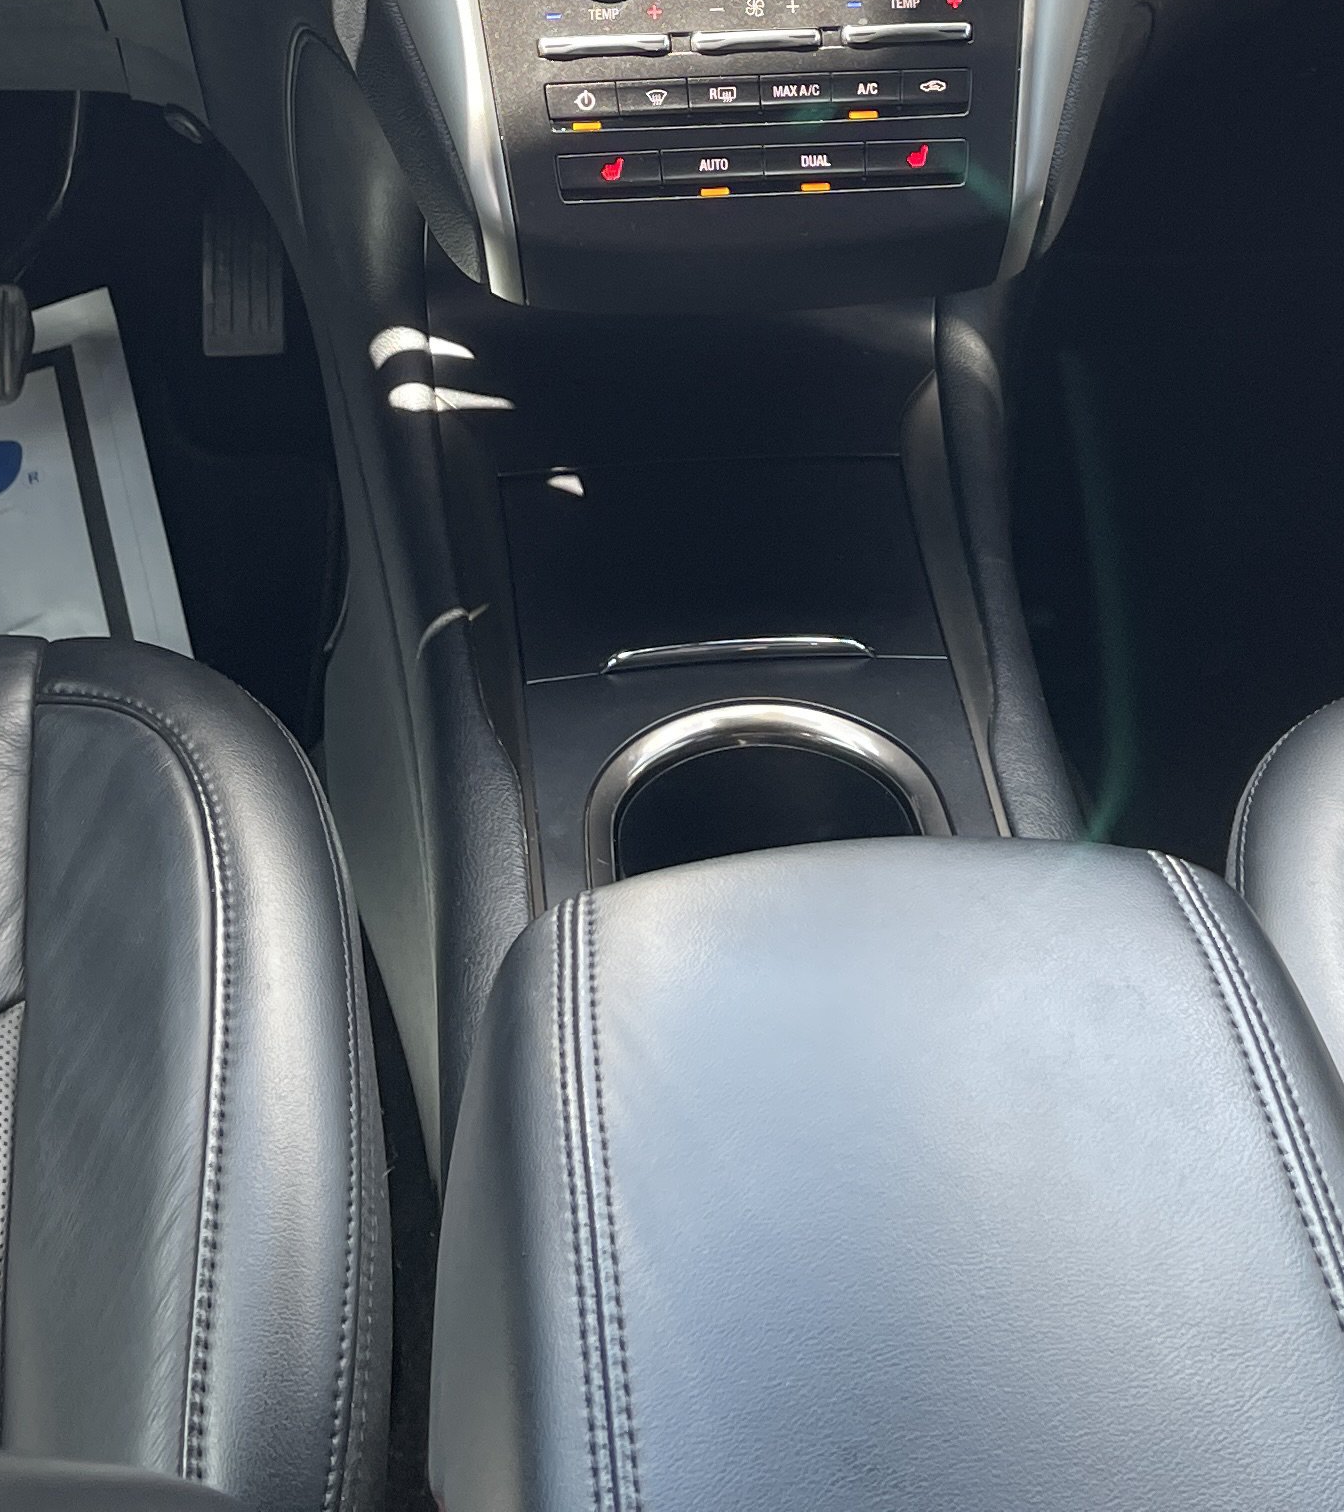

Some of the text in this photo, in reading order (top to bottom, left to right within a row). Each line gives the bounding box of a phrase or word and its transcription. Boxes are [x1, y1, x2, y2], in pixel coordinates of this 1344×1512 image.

[588, 8, 620, 21] TEMP
[709, 88, 717, 99] R
[773, 84, 820, 98] MAX A/C
[857, 82, 878, 95] A/C
[699, 159, 728, 172] AUTO
[800, 154, 831, 168] DUAL
